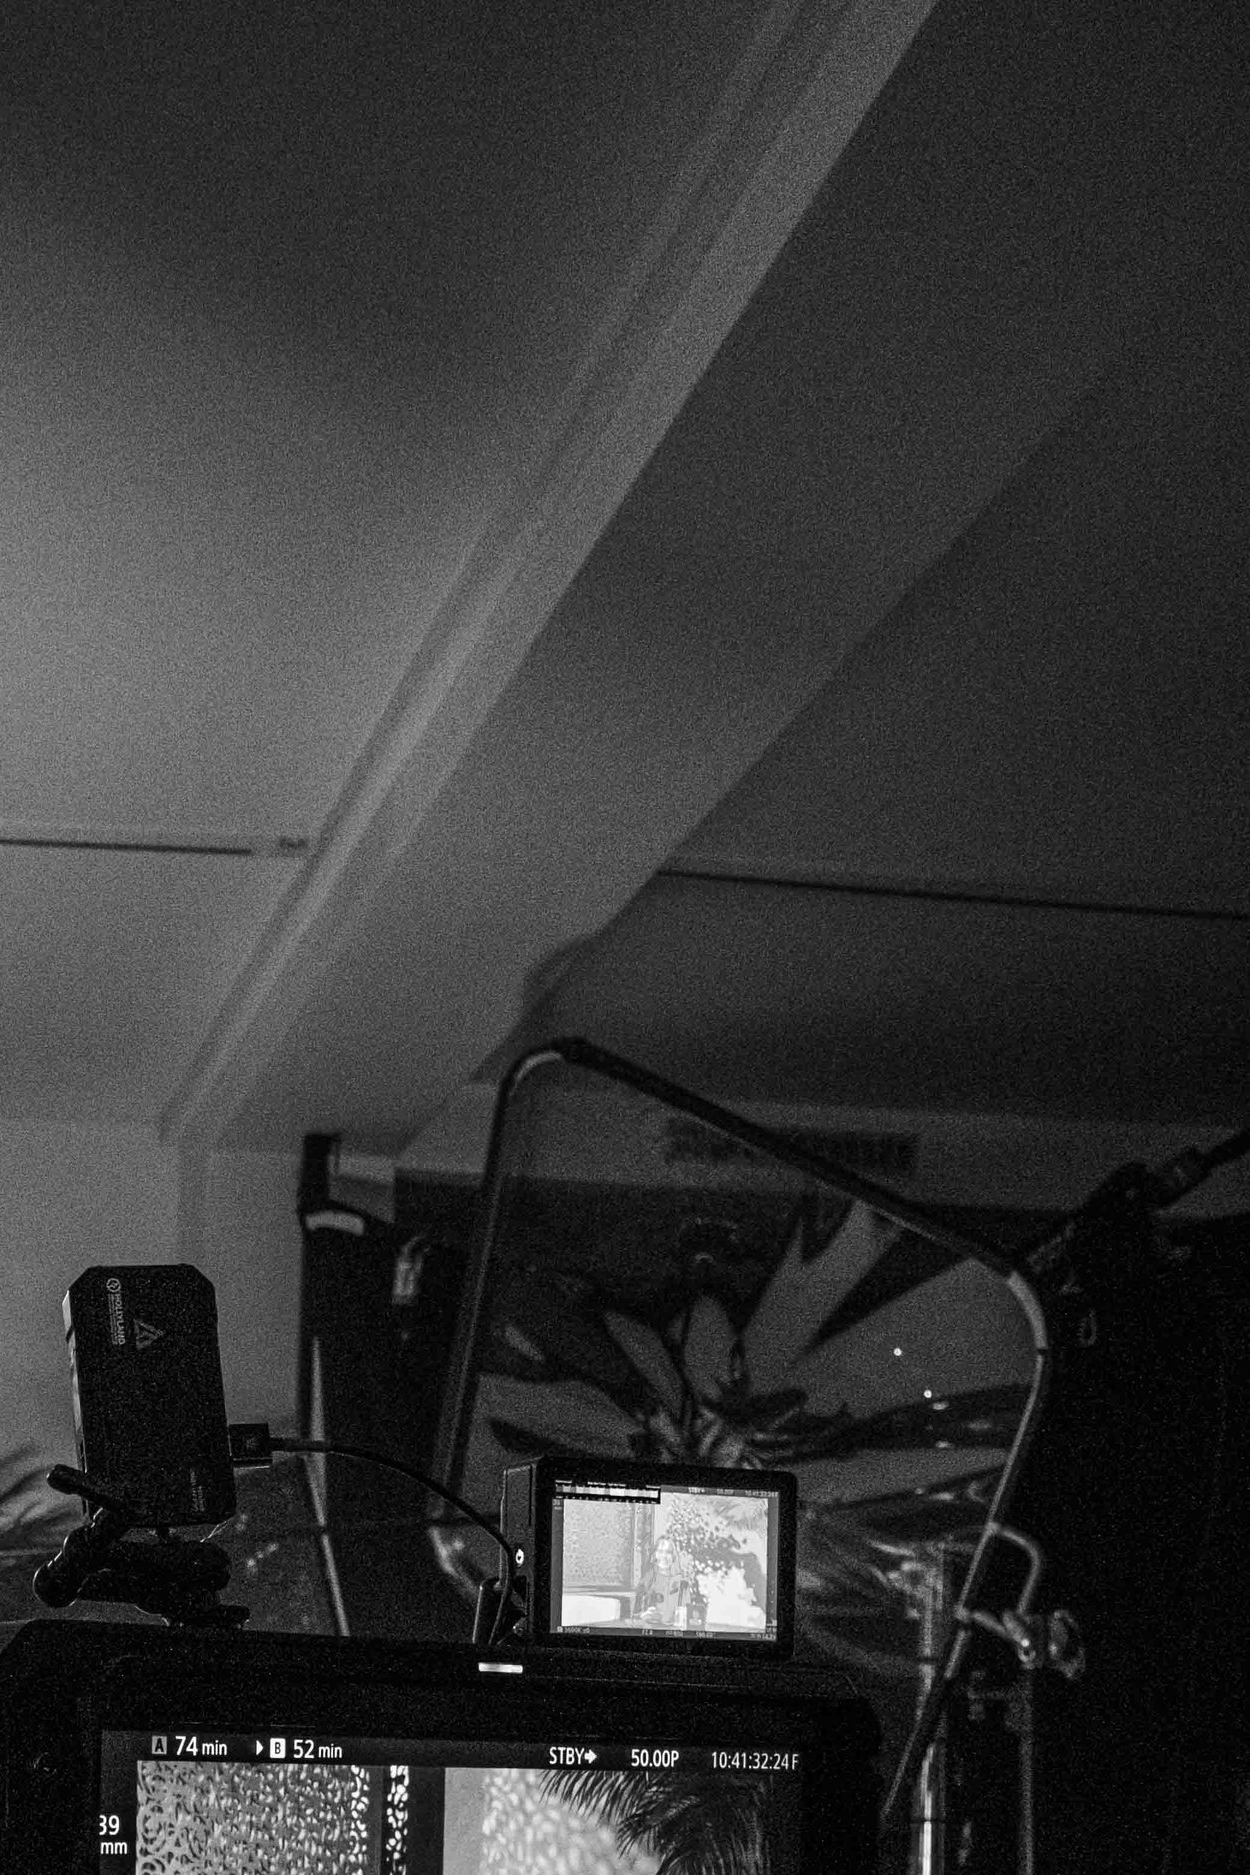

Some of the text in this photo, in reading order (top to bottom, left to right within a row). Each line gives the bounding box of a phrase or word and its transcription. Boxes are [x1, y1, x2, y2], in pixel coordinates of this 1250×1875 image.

[174, 1735, 199, 1757] 74
[201, 1739, 228, 1757] min
[293, 1738, 315, 1760] 52
[318, 1743, 343, 1759] min
[549, 1746, 586, 1766] STBY
[631, 1748, 680, 1768] 50.00P
[100, 1841, 128, 1855] mm
